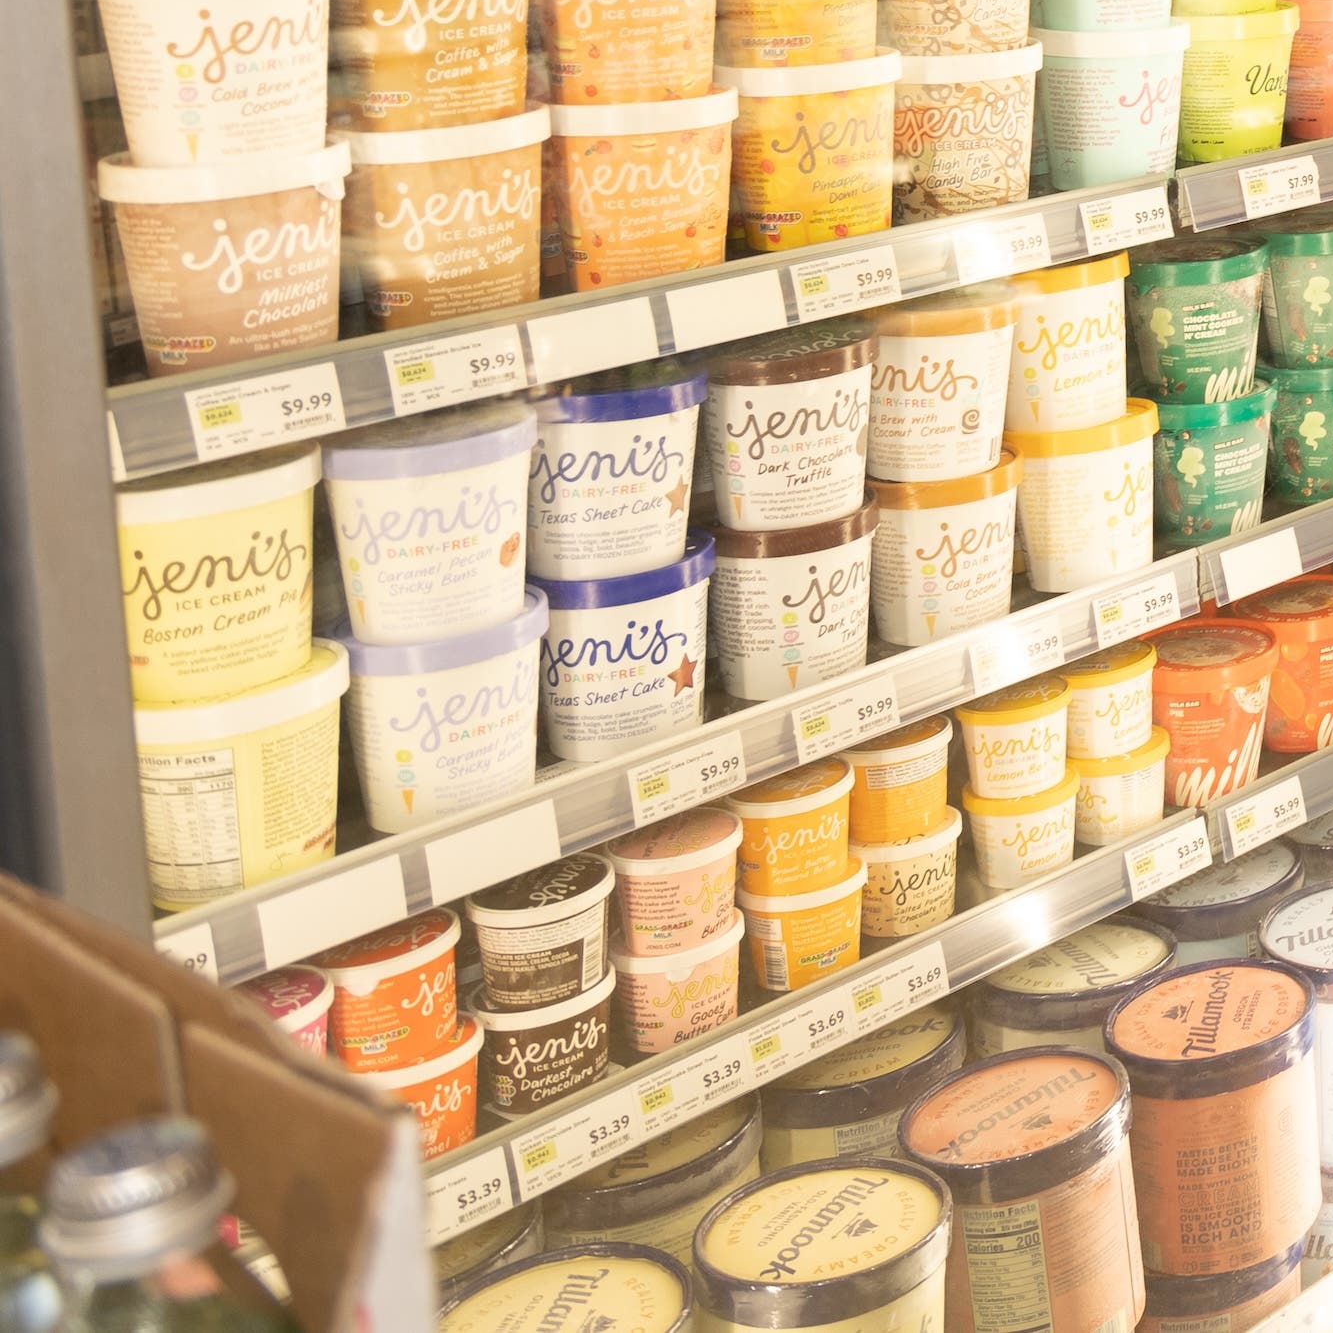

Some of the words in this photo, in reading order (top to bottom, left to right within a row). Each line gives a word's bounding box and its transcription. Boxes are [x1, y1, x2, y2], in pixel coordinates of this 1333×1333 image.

[426, 66, 474, 83] Cream
[932, 158, 961, 172] High
[966, 154, 991, 166] Five
[926, 174, 963, 190] Candy
[971, 167, 993, 183] Bar
[1288, 174, 1314, 190] $7.99
[376, 168, 539, 252] jeni's
[1136, 208, 1165, 224] $9.99
[434, 244, 480, 266] Coffee
[426, 265, 473, 284] Cream
[857, 268, 893, 287] $9.99
[259, 275, 329, 307] Milkiest
[243, 293, 329, 327] Chocolate
[1183, 311, 1239, 324] CHOCOLATE
[471, 352, 515, 374] $9.99
[281, 393, 332, 416] $9.99
[920, 423, 956, 435] Cream
[530, 435, 683, 503] jeni's
[758, 460, 790, 474] Dark
[798, 445, 852, 467] Chocolate
[786, 468, 832, 488] Truffle
[562, 483, 646, 498] DAIRY-FREE
[540, 509, 577, 525] Texas
[582, 505, 626, 522] Sheet
[632, 497, 665, 514] Cake
[387, 537, 479, 559] DAIRY-FREE
[121, 530, 306, 622] jeni's
[378, 561, 441, 583] Caramel
[449, 548, 493, 568] Pecan
[389, 579, 434, 597] Sticky
[441, 568, 478, 584] Buns
[1145, 593, 1173, 612] $9.99
[143, 625, 203, 644] Boston
[214, 607, 271, 630] Cream
[280, 590, 297, 607] Pie
[548, 692, 582, 707] Texas
[586, 686, 627, 704] Sheet
[633, 675, 665, 697] Cake
[858, 698, 893, 721] $9.99
[971, 723, 1060, 768] jeni's
[700, 757, 740, 781] $9.99
[1274, 798, 1299, 818] $5.99
[1178, 837, 1205, 858] $3.39
[907, 967, 941, 991] $3.69
[1183, 970, 1234, 1057] Tillamook
[1233, 994, 1251, 1023] OREGON
[1242, 989, 1263, 1030] STRAWBERRY
[809, 1010, 845, 1037] $3.69
[496, 1016, 606, 1079] jeni's
[520, 1070, 572, 1093] Darkest
[532, 1069, 593, 1102] Chocolate
[703, 1060, 742, 1088] $3.39
[589, 1115, 630, 1144] $3.39
[457, 1178, 502, 1210] $3.39
[759, 1178, 888, 1280] Tillamook
[967, 1243, 1004, 1253] Calories
[1016, 1233, 1039, 1248] 200
